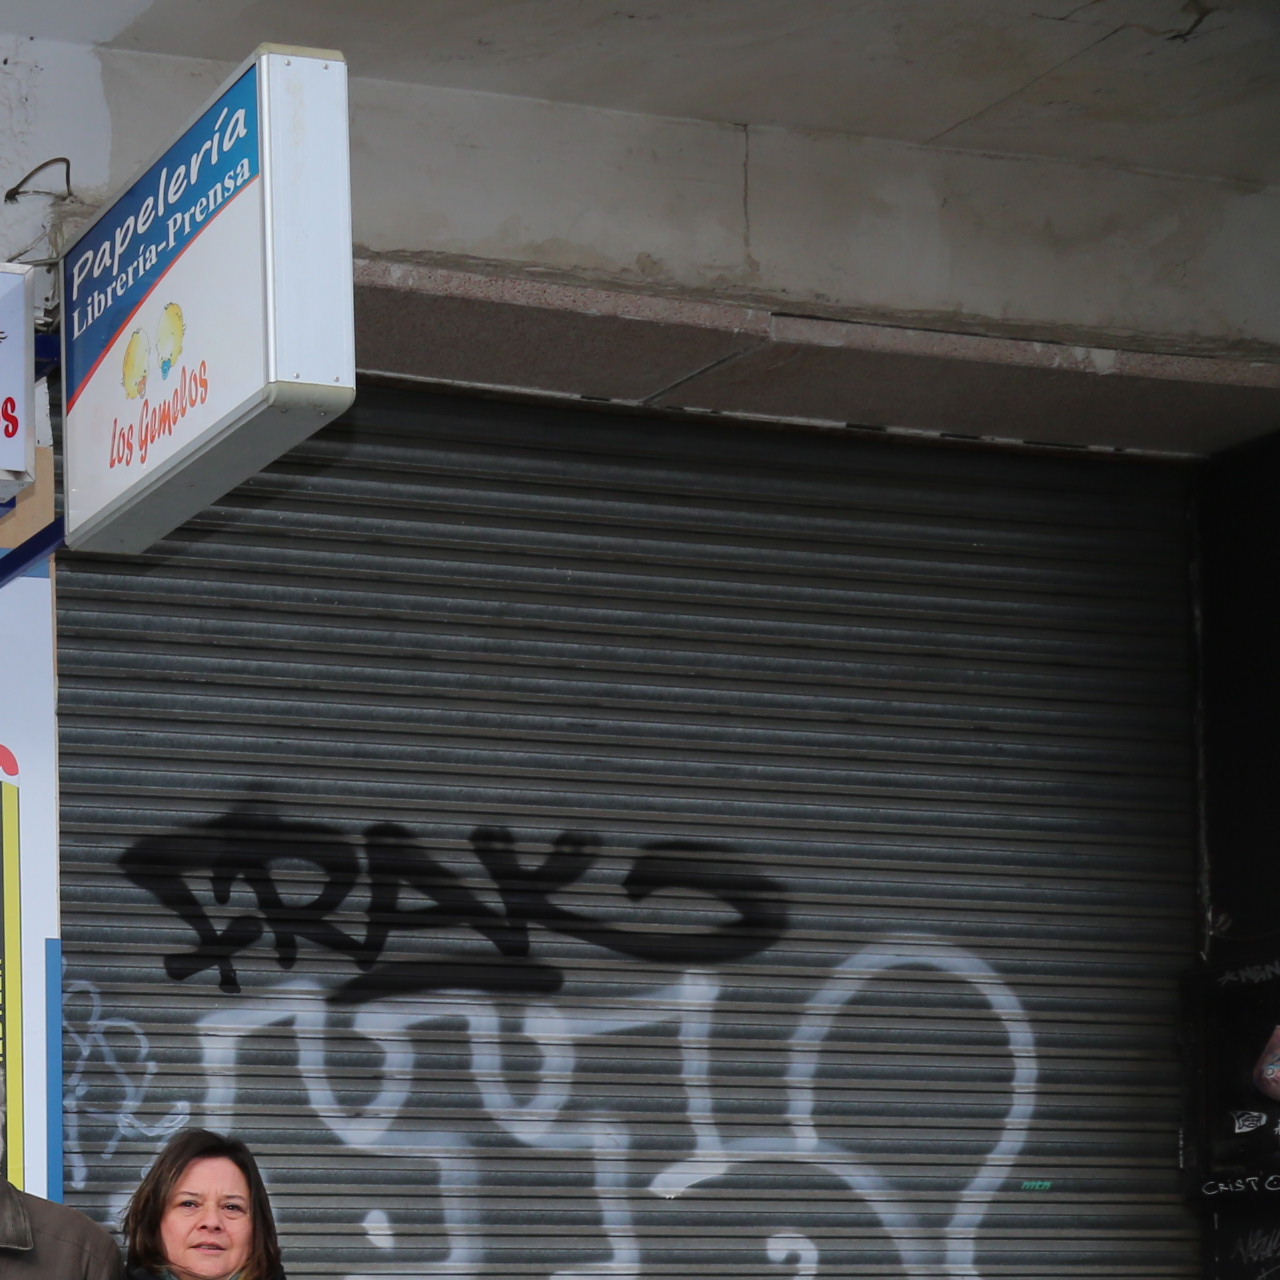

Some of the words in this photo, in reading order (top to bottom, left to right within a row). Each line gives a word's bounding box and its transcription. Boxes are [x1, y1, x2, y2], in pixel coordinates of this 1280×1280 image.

[71, 106, 249, 301] Papelería
[72, 158, 251, 340] Librería-Prensa
[109, 417, 134, 469] Los
[138, 359, 209, 465] Gemelos
